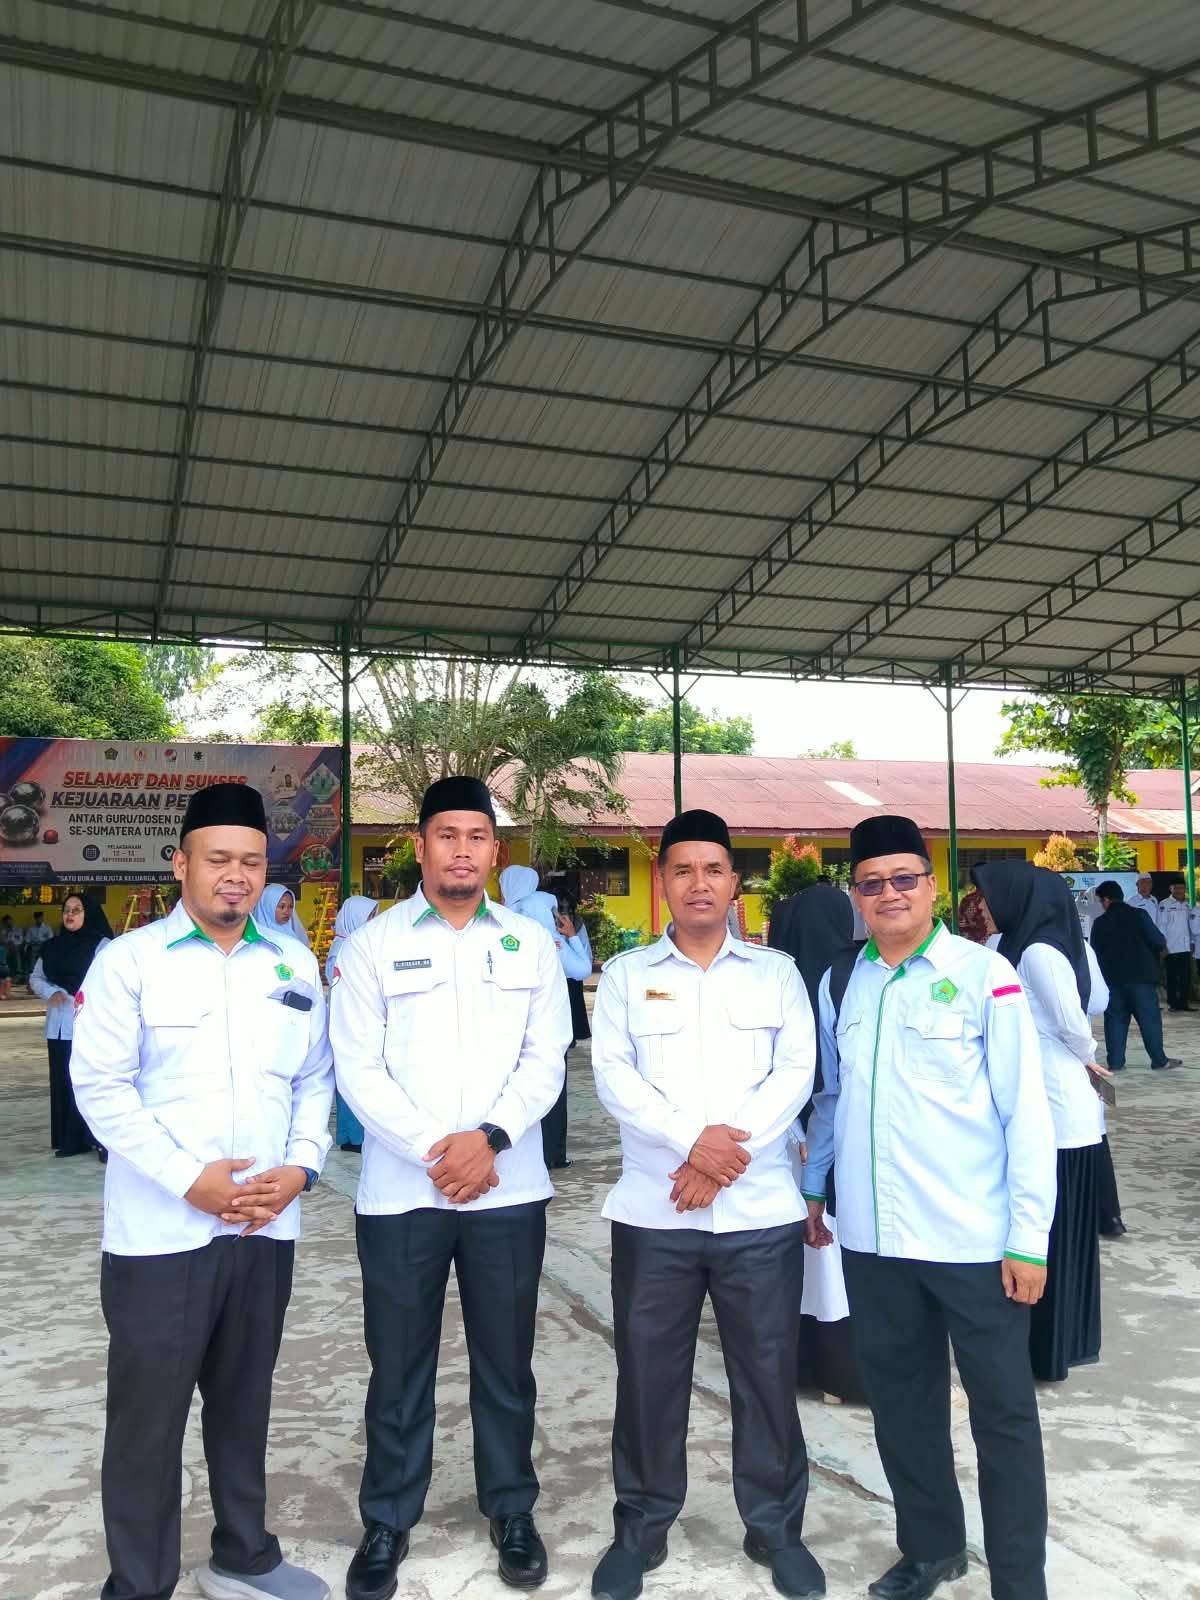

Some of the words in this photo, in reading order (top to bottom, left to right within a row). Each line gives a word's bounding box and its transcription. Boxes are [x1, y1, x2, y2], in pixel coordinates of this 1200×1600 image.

[63, 771, 144, 789] SELAMAT
[144, 773, 183, 790] DAN
[50, 791, 161, 809] KEJUARAAN
[68, 813, 103, 824] ANTAR
[105, 814, 172, 824] GURU/DOSEN
[69, 825, 141, 836] SE-SUMATERA
[144, 827, 177, 836] UTARA
